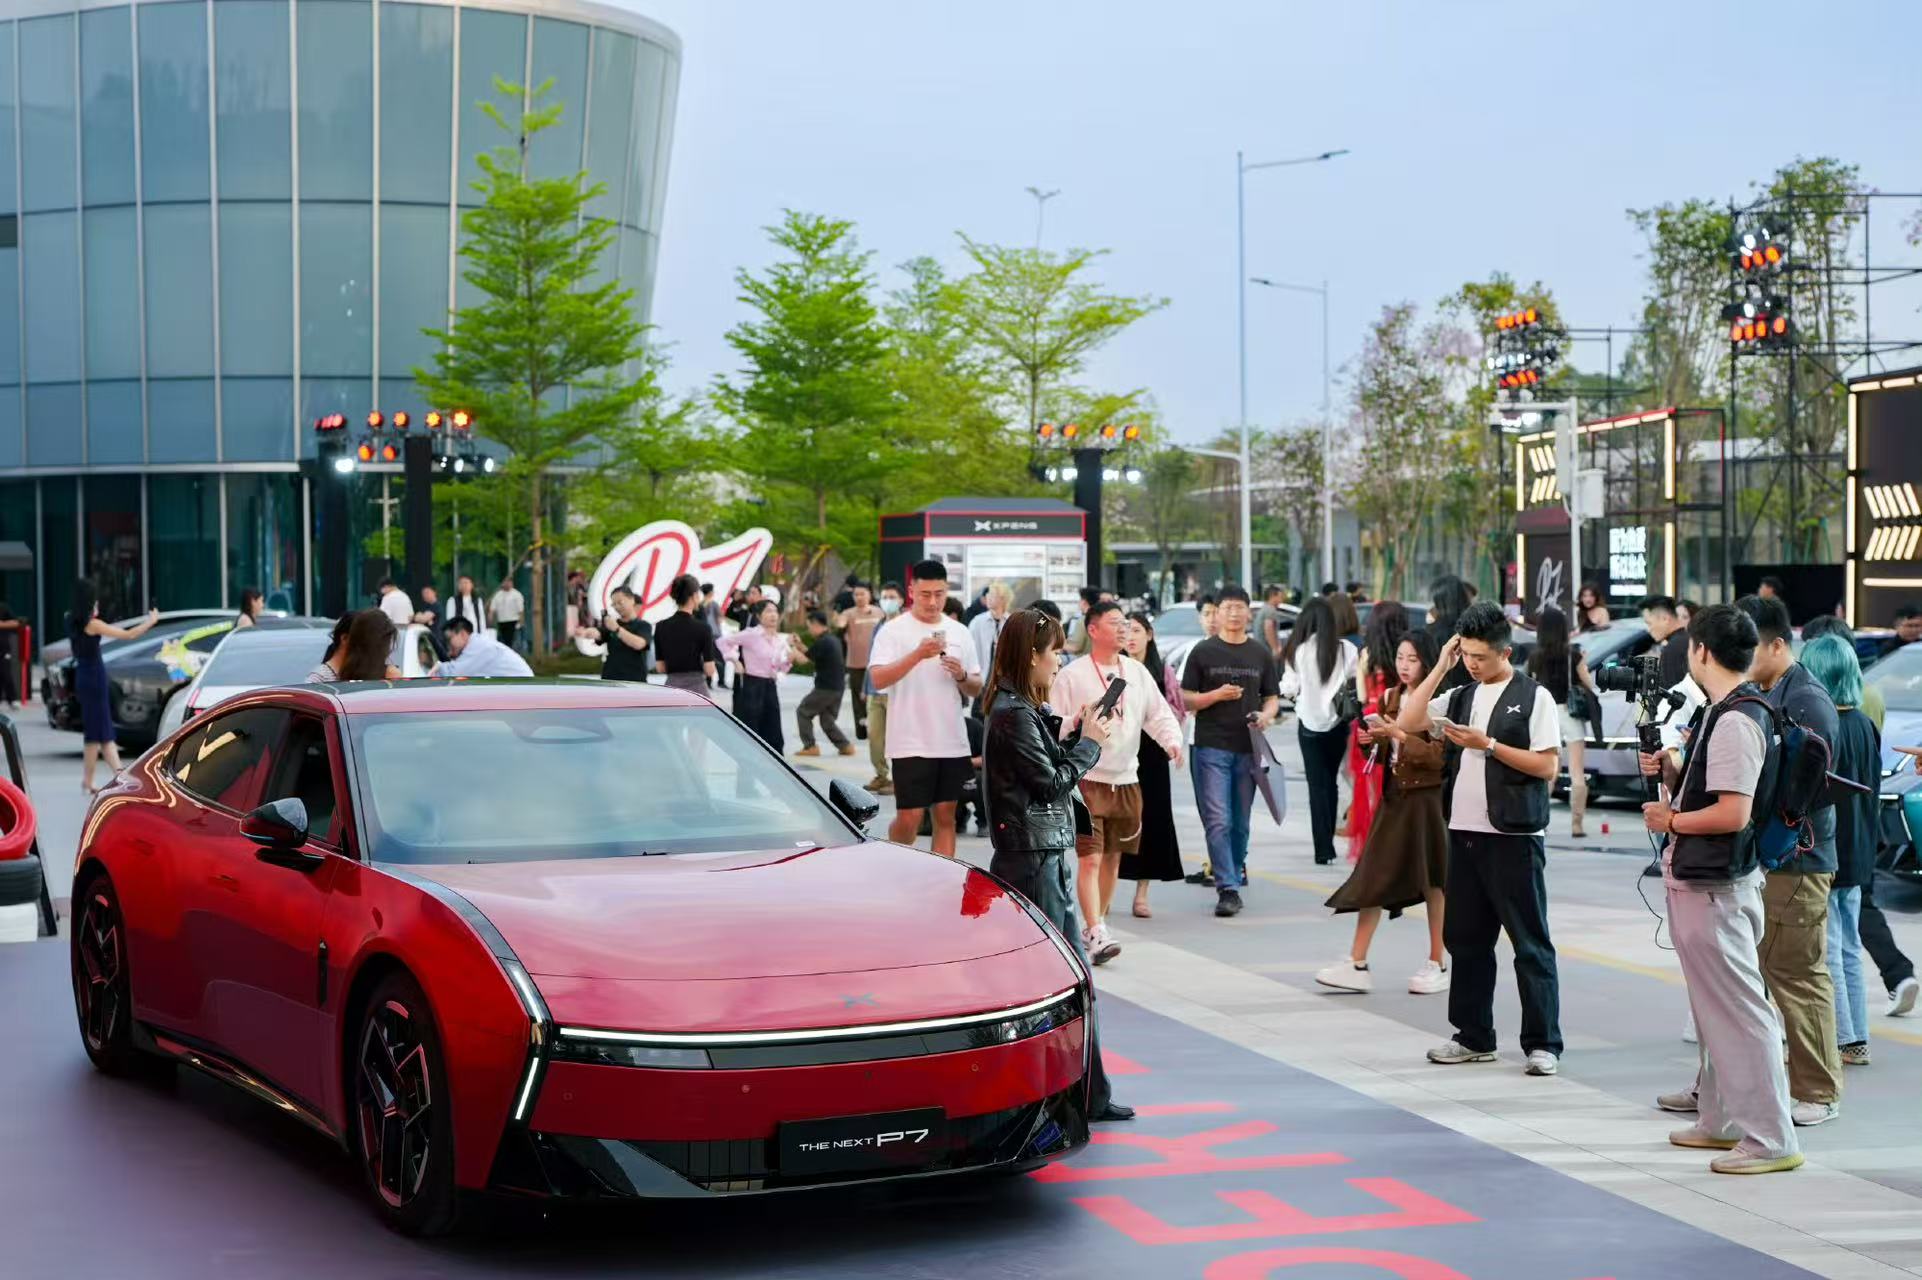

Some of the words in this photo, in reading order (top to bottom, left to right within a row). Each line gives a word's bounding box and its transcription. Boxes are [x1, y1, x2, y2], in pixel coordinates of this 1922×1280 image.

[799, 1141, 830, 1151] THE
[833, 1137, 874, 1149] NEXT
[876, 1128, 929, 1147] P7
